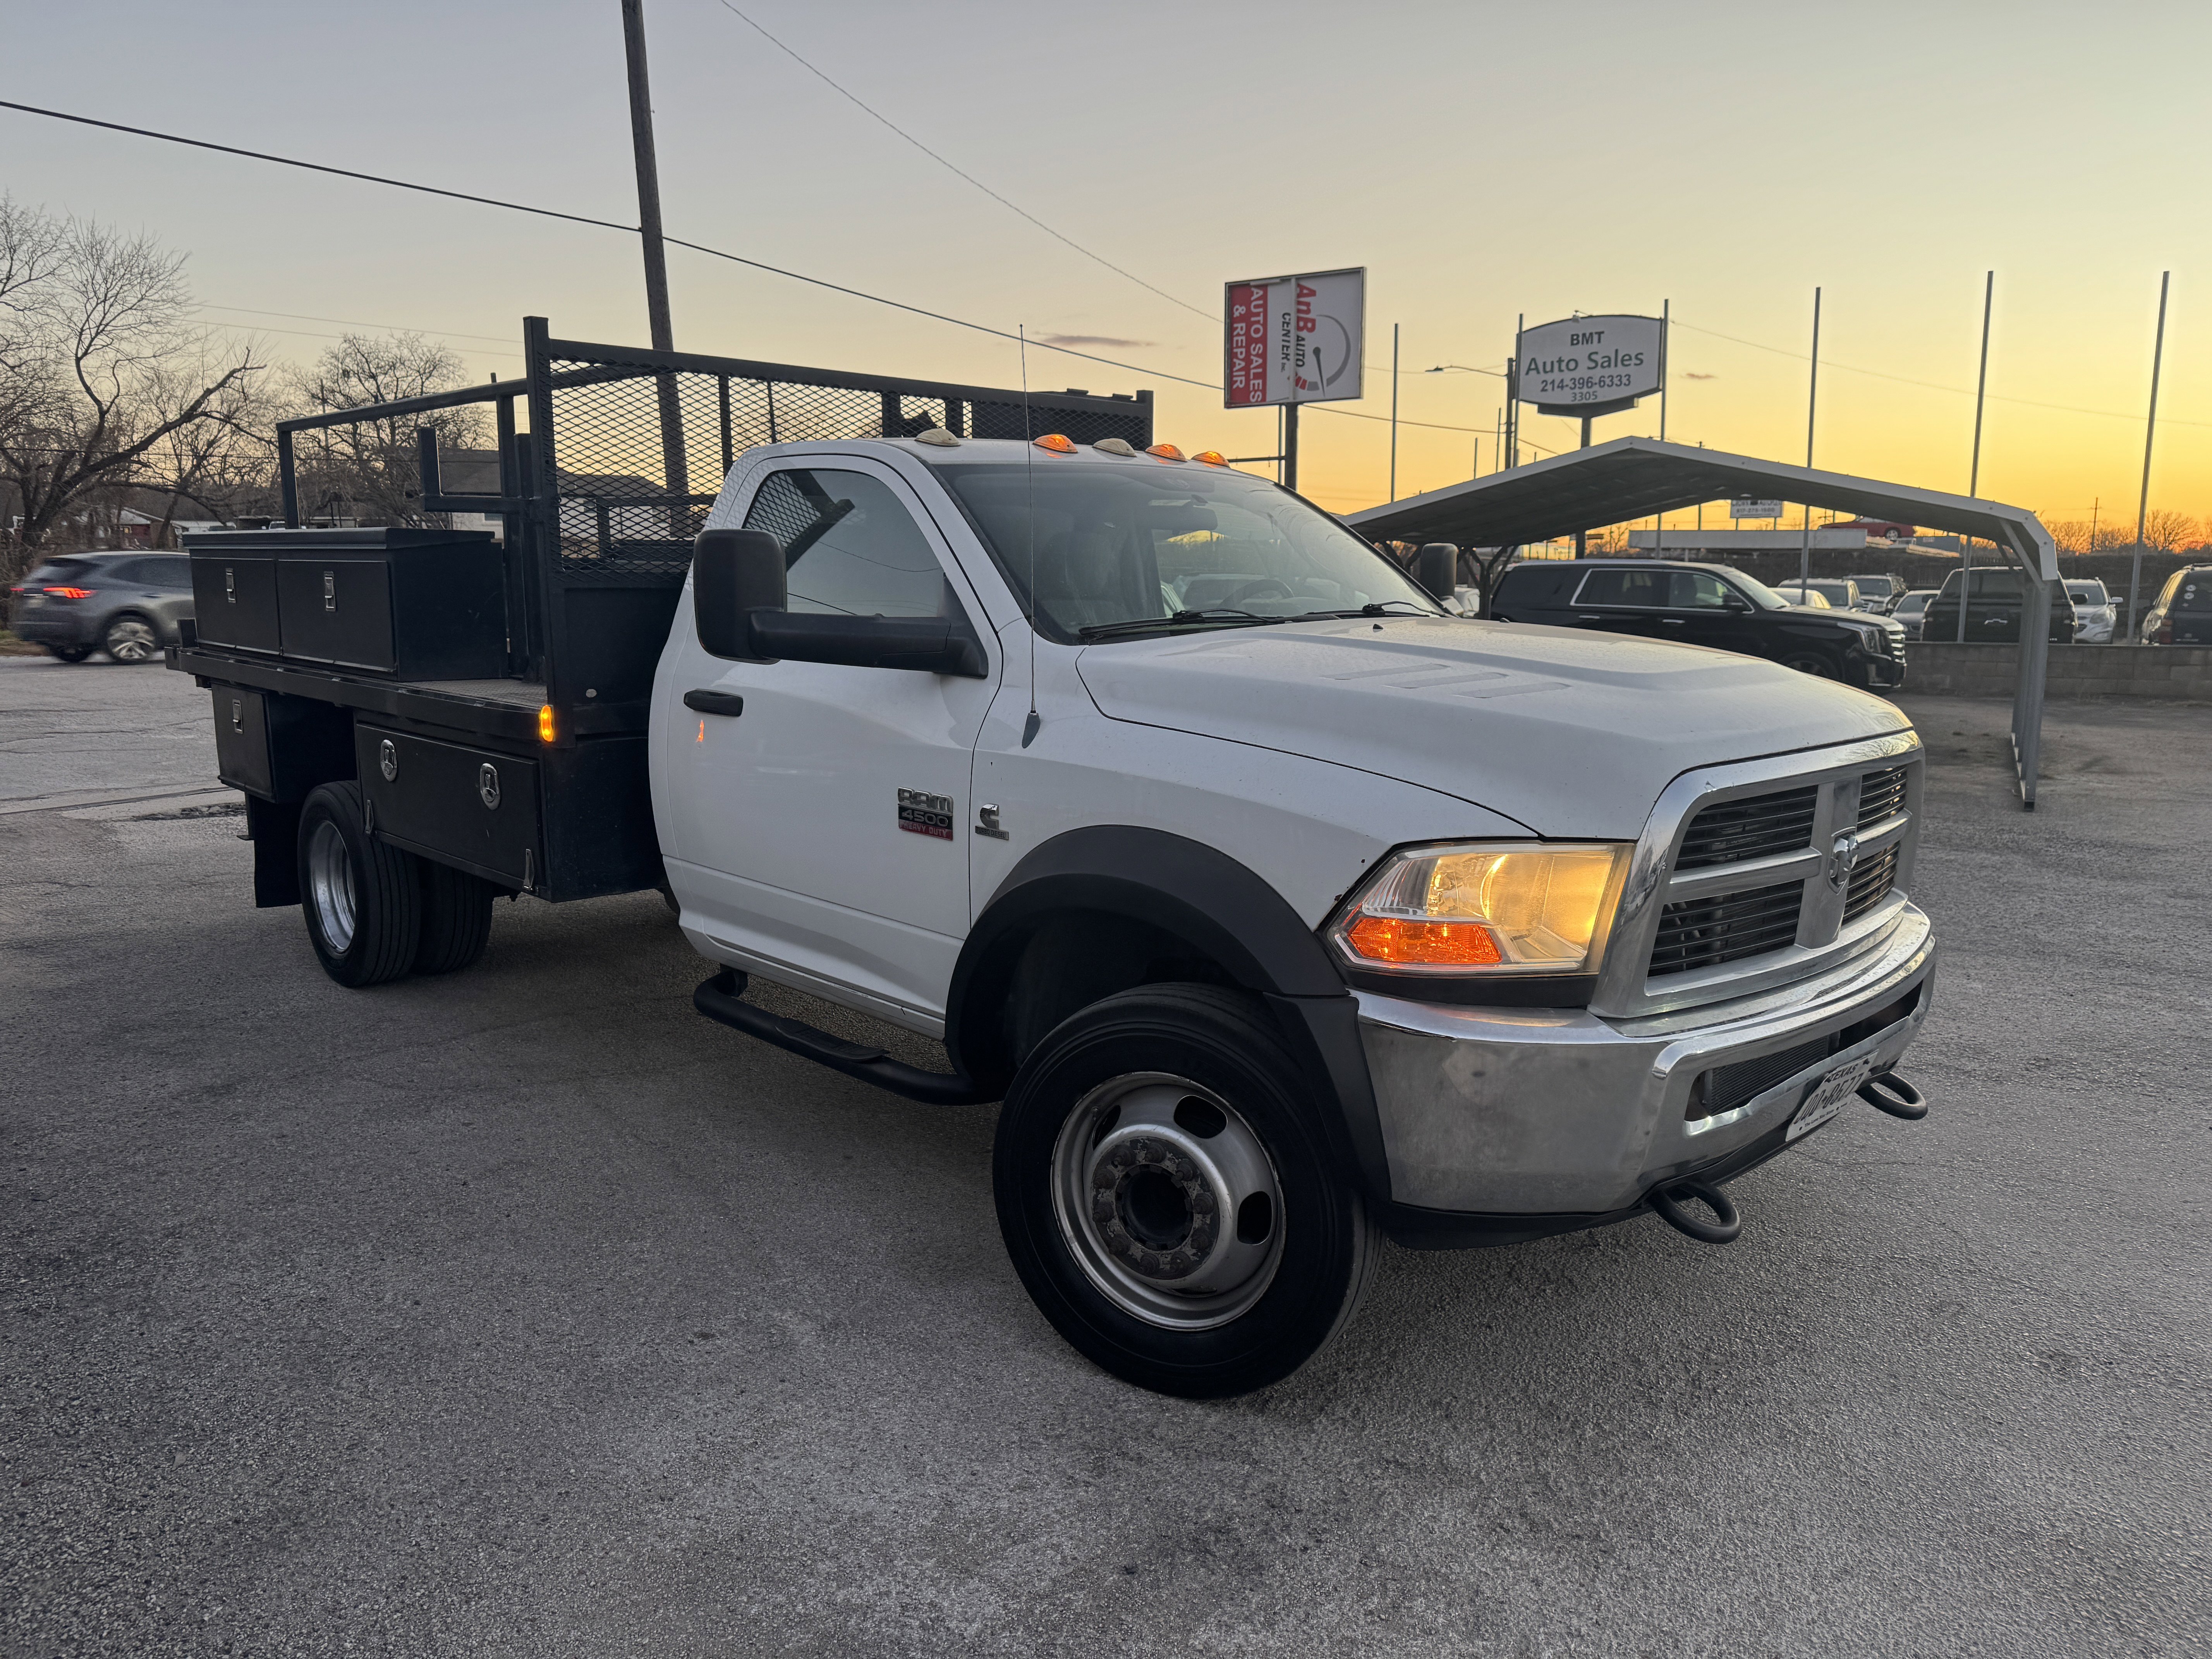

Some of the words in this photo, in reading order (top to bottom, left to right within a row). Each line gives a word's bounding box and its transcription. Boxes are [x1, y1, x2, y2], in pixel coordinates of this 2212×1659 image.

[1233, 305, 1246, 317] &
[1250, 287, 1264, 338] AUTO
[1297, 283, 1316, 333] AnB
[1570, 331, 1605, 346] BMT
[1233, 323, 1246, 389] REPAIR
[1296, 334, 1305, 367] AUTO
[1525, 356, 1579, 375] Auto
[1587, 349, 1644, 370] Sales
[1249, 343, 1263, 403] SALES
[1540, 374, 1631, 392] 214-396-6333
[1571, 390, 1598, 402] 3305
[902, 809, 948, 827] 4500
[903, 821, 926, 833] HEAVY
[929, 827, 947, 838] DUTY
[1829, 1063, 1858, 1081] TEXAS
